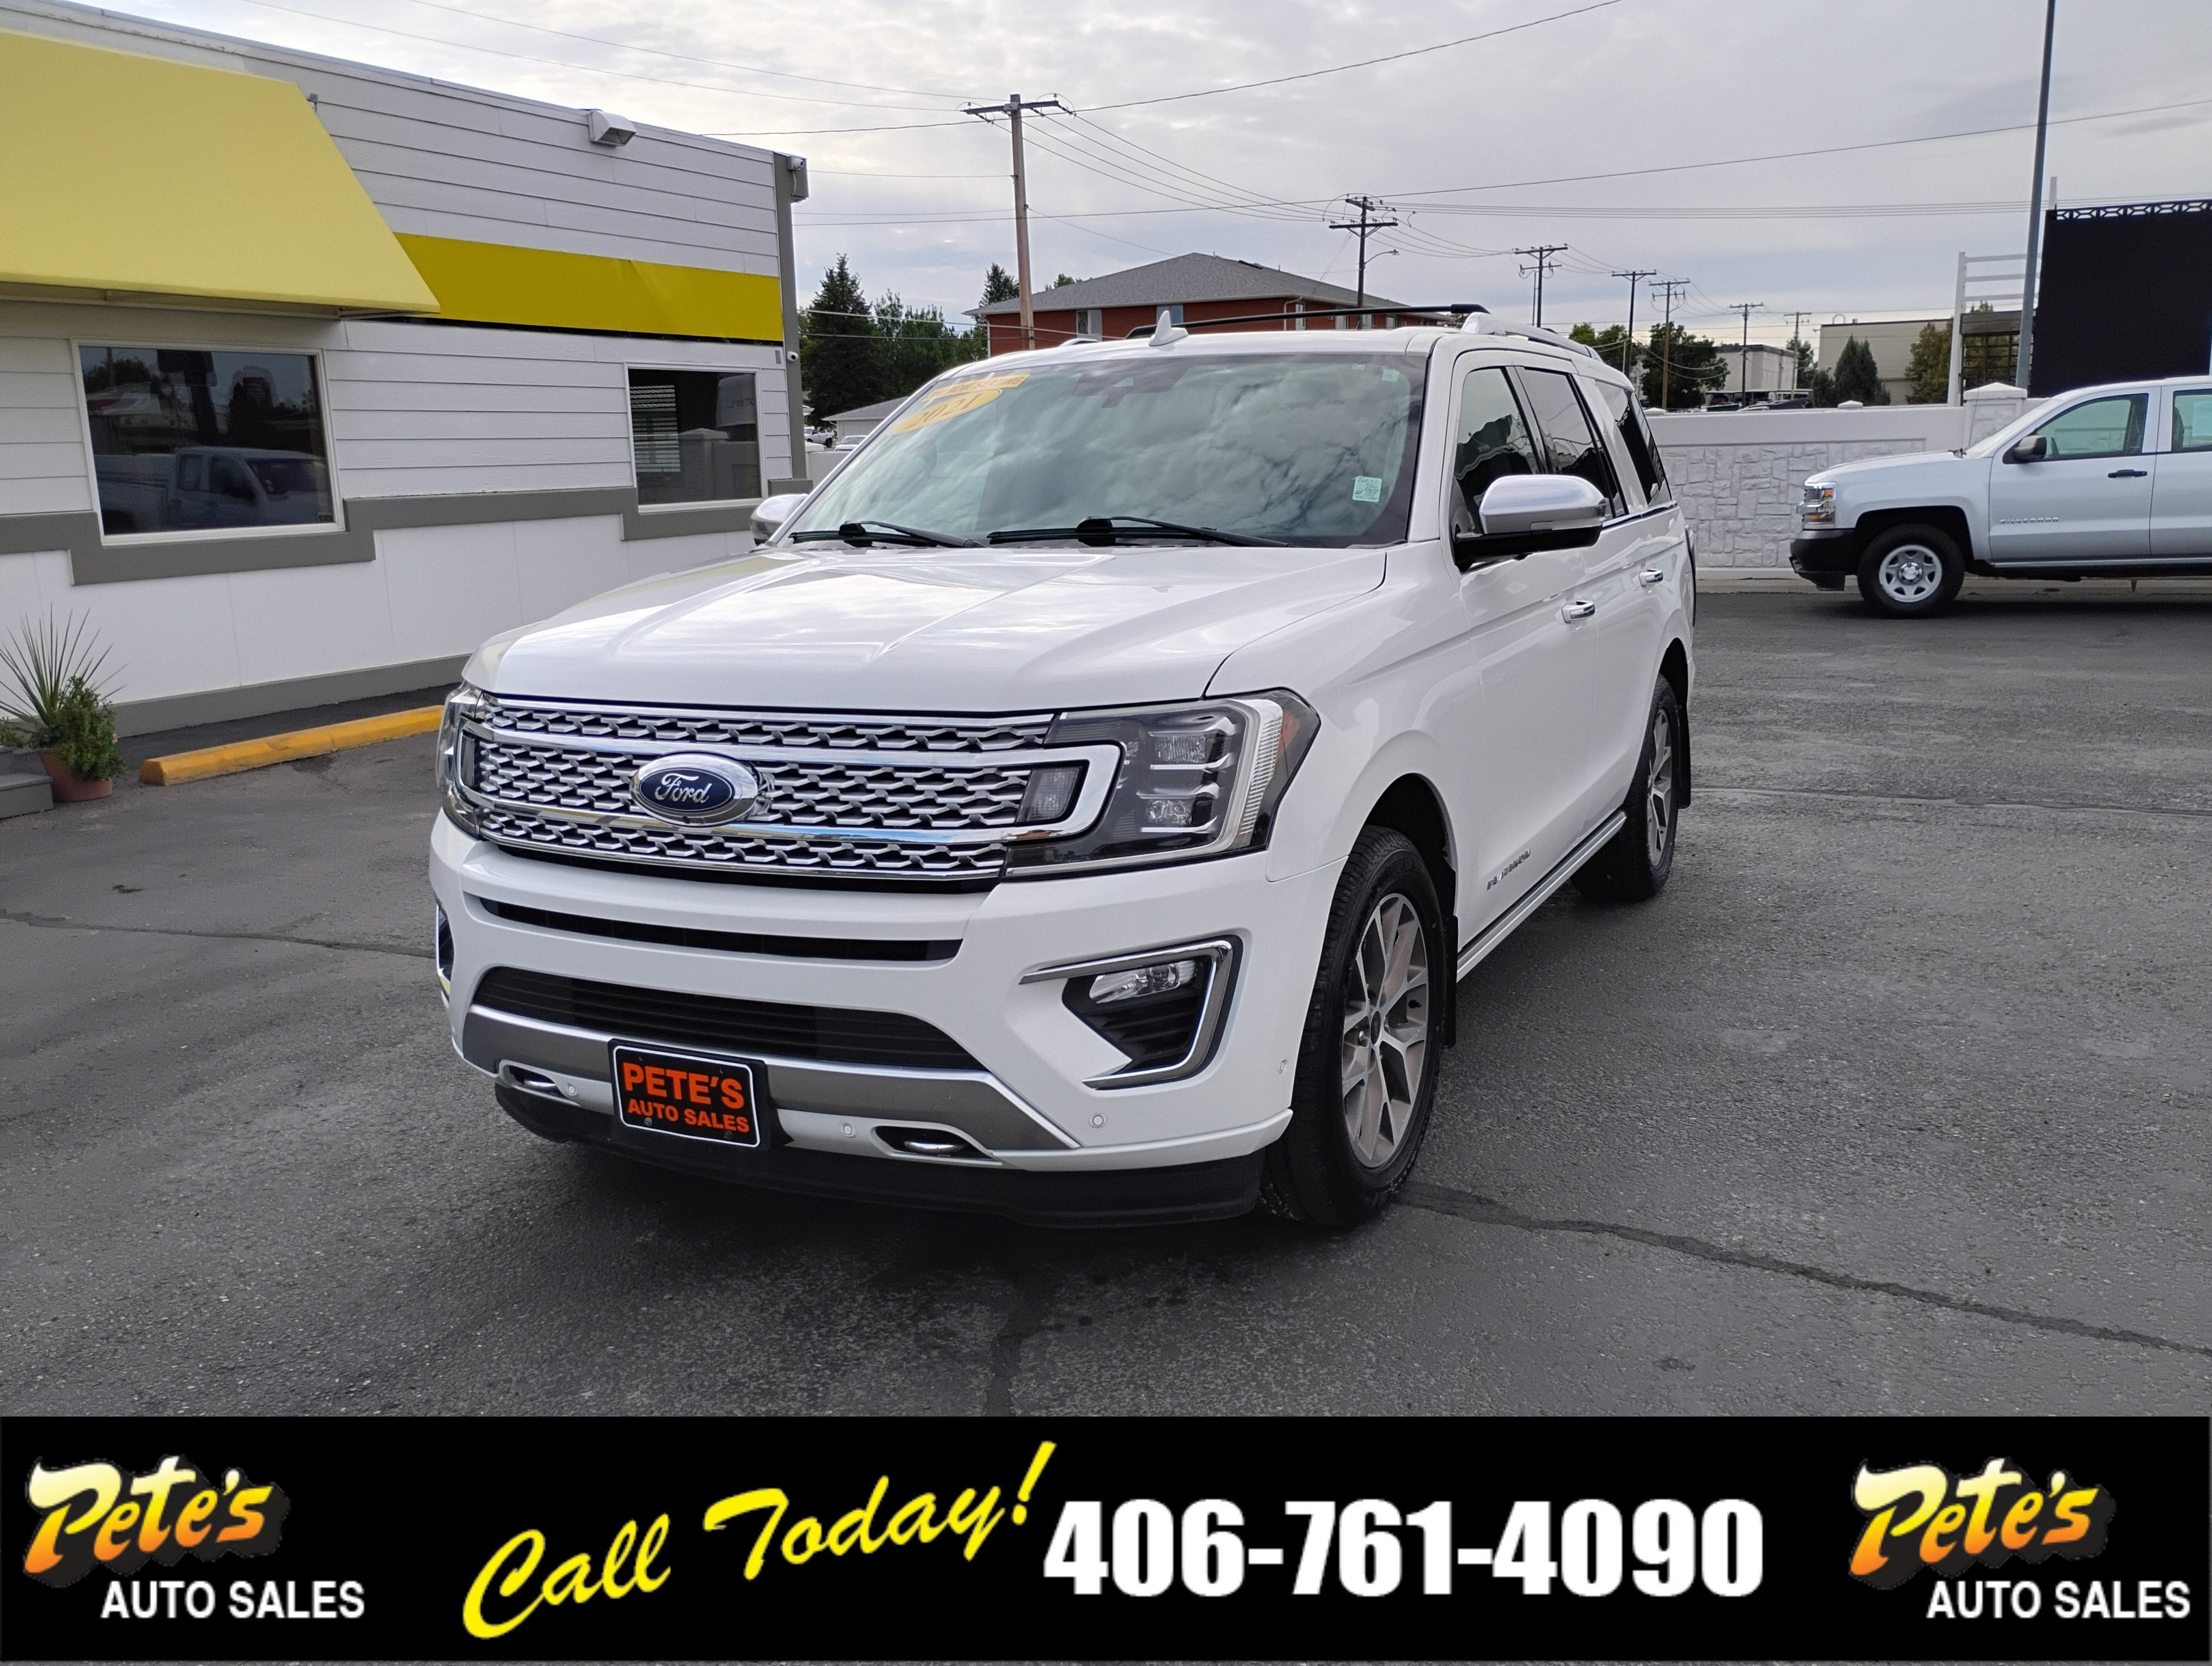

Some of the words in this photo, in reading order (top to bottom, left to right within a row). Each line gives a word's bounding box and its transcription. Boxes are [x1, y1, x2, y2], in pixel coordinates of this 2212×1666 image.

[904, 392, 983, 430] 2021
[655, 773, 712, 803] Ford
[622, 1062, 744, 1108] PETE'S
[628, 1099, 678, 1122] AUTO
[684, 1108, 749, 1132] SALES
